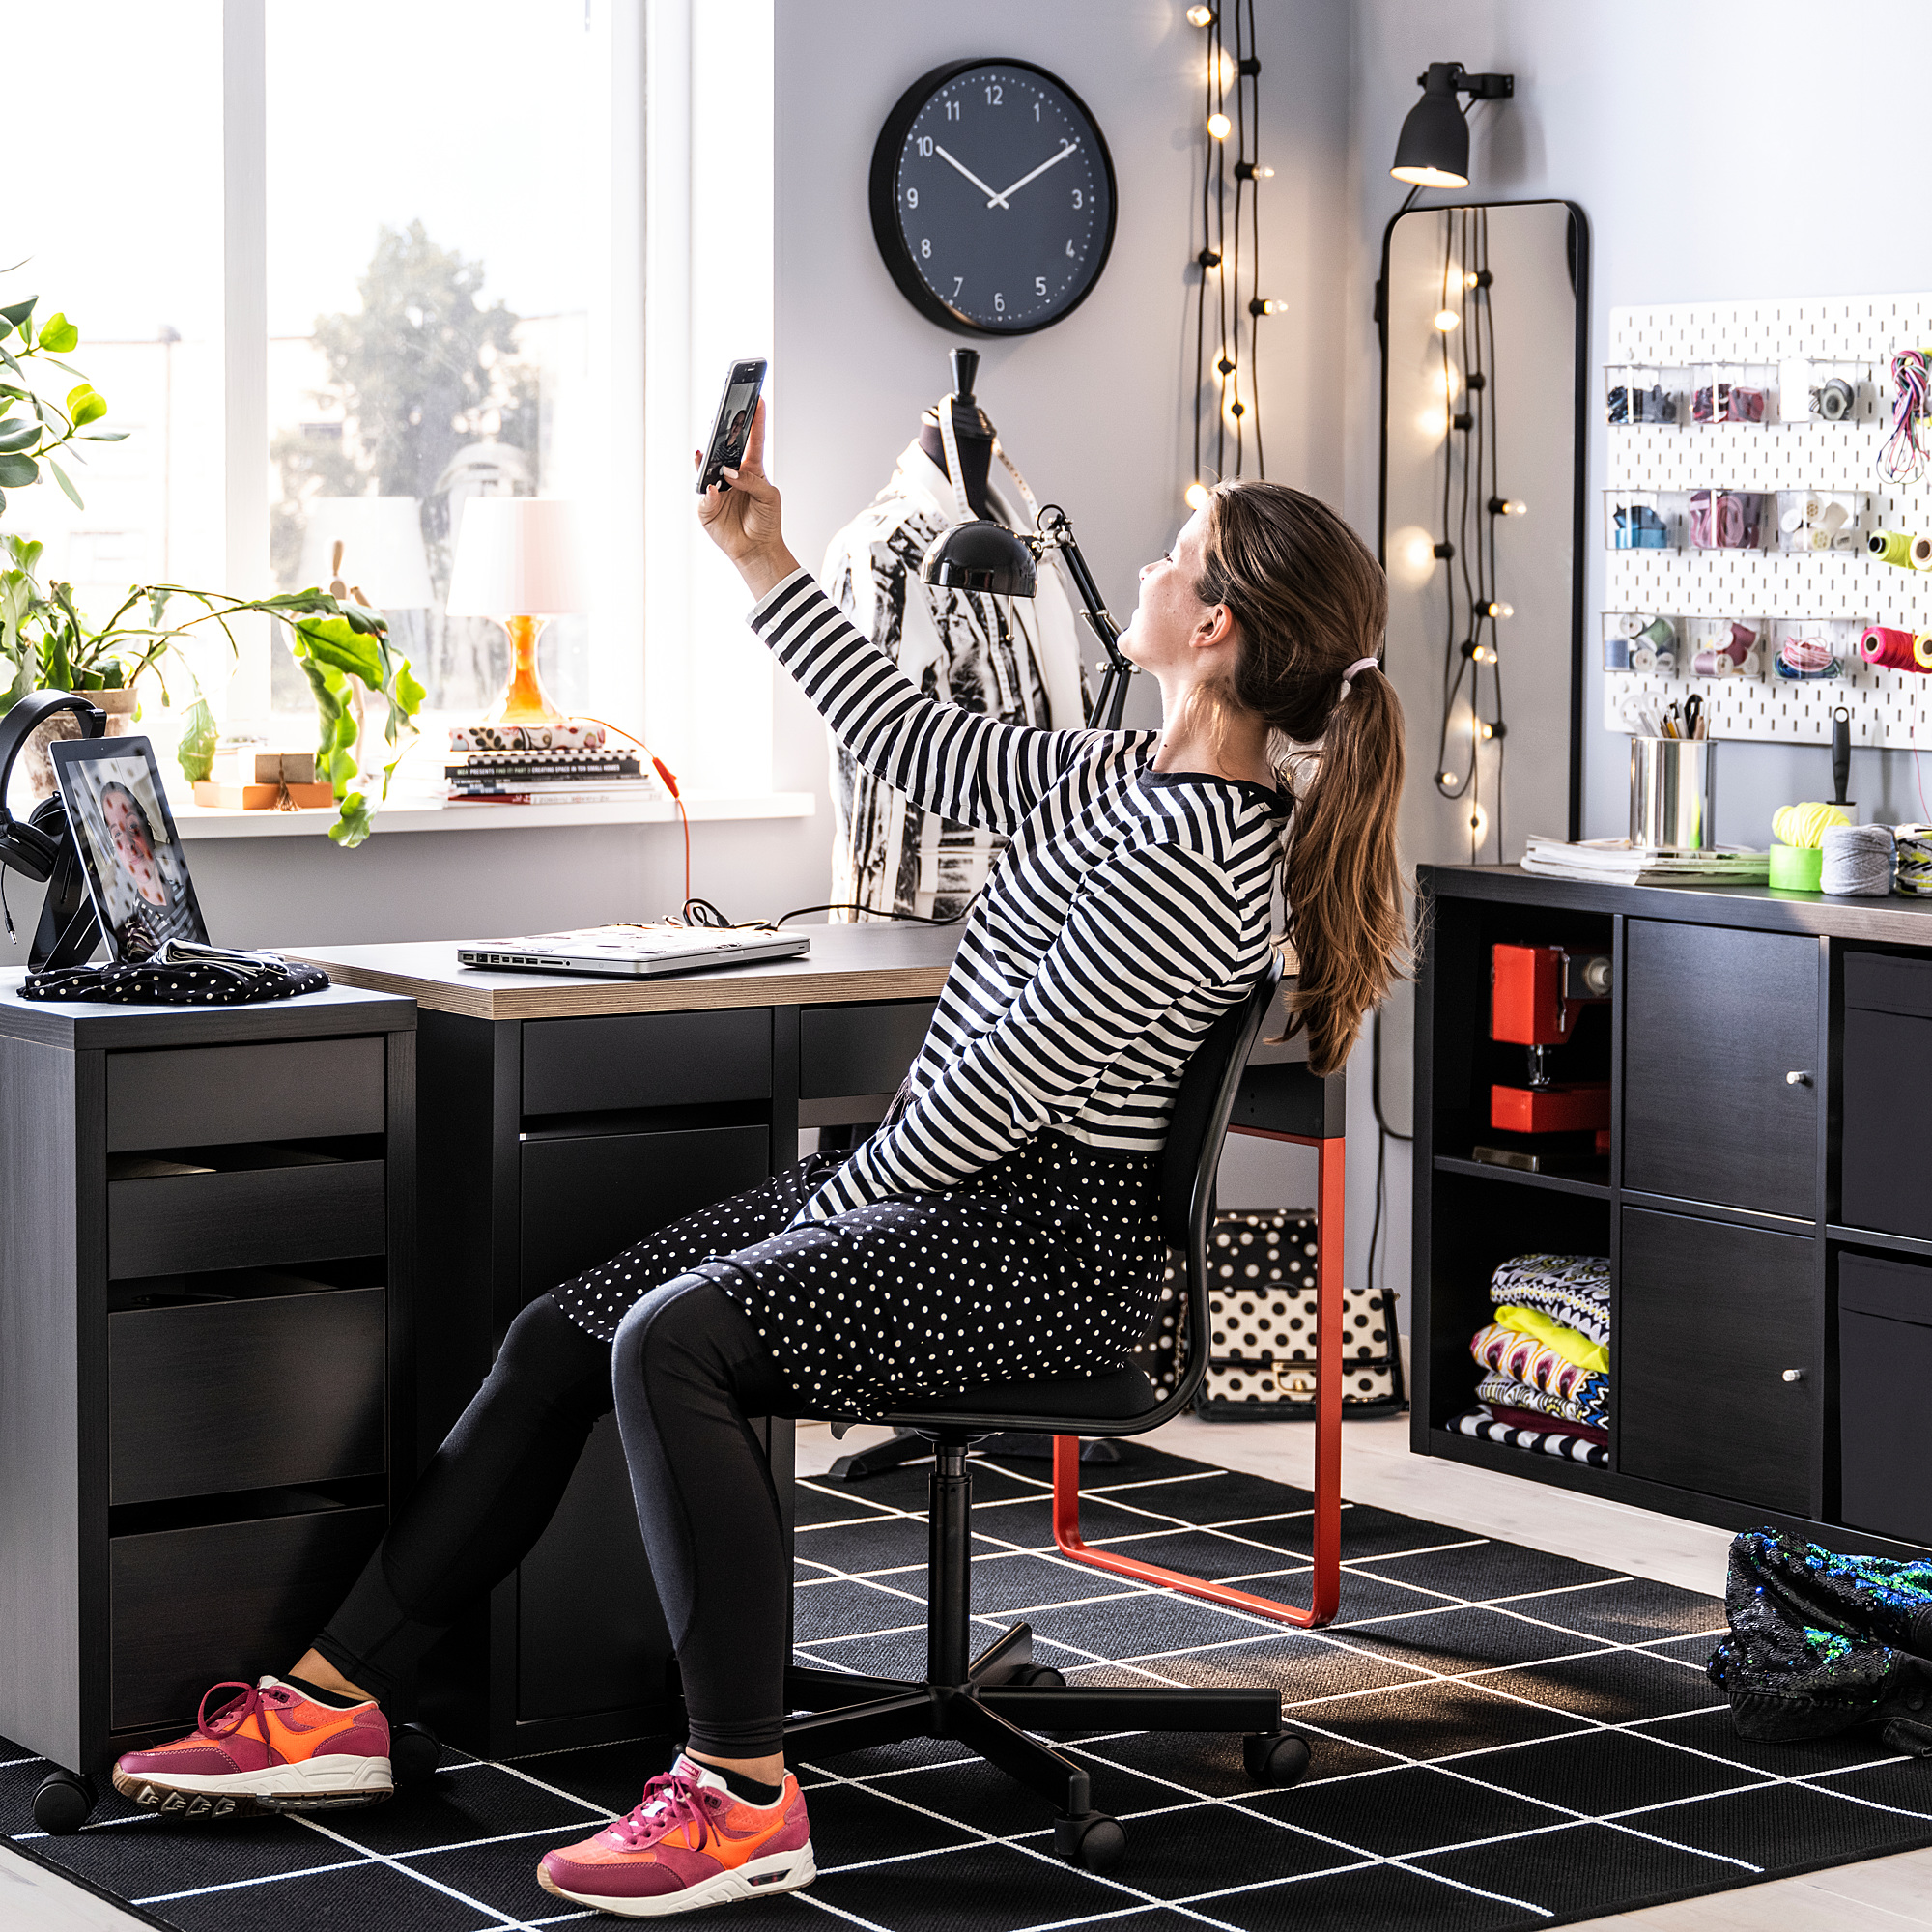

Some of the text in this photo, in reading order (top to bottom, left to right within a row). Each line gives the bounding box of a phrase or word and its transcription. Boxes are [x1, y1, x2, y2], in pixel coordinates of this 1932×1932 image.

[984, 85, 1003, 105] 12
[945, 100, 960, 121] 11
[1033, 102, 1040, 122] 1
[916, 135, 933, 157] 10
[906, 187, 919, 209] 9
[1071, 189, 1083, 210] 3
[921, 238, 932, 259] 8
[1065, 239, 1075, 258] 4
[953, 276, 964, 298] 7
[1035, 276, 1047, 297] 5
[994, 292, 1006, 312] 6
